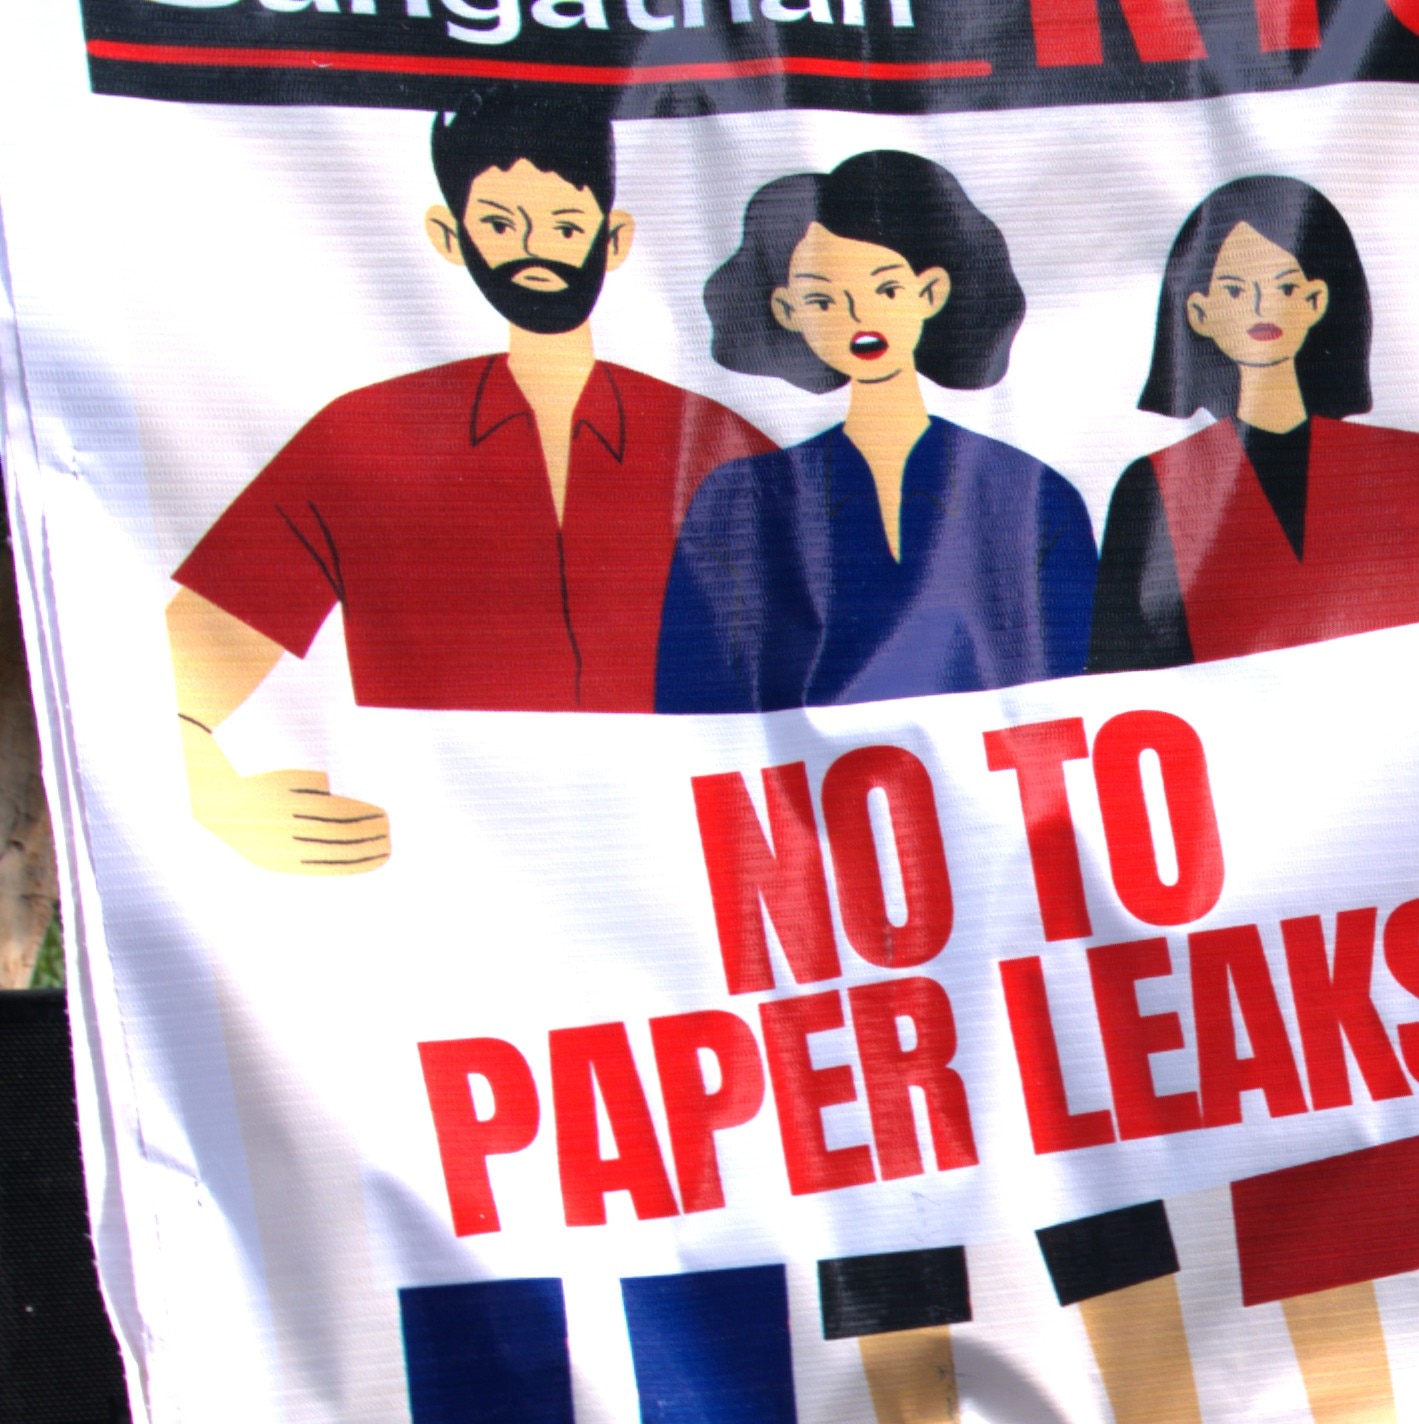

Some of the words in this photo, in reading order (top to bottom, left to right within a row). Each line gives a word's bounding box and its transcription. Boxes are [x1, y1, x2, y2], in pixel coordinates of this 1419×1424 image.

[692, 745, 953, 995] NO
[983, 710, 1223, 942] TO
[419, 976, 980, 1237] PAPER
